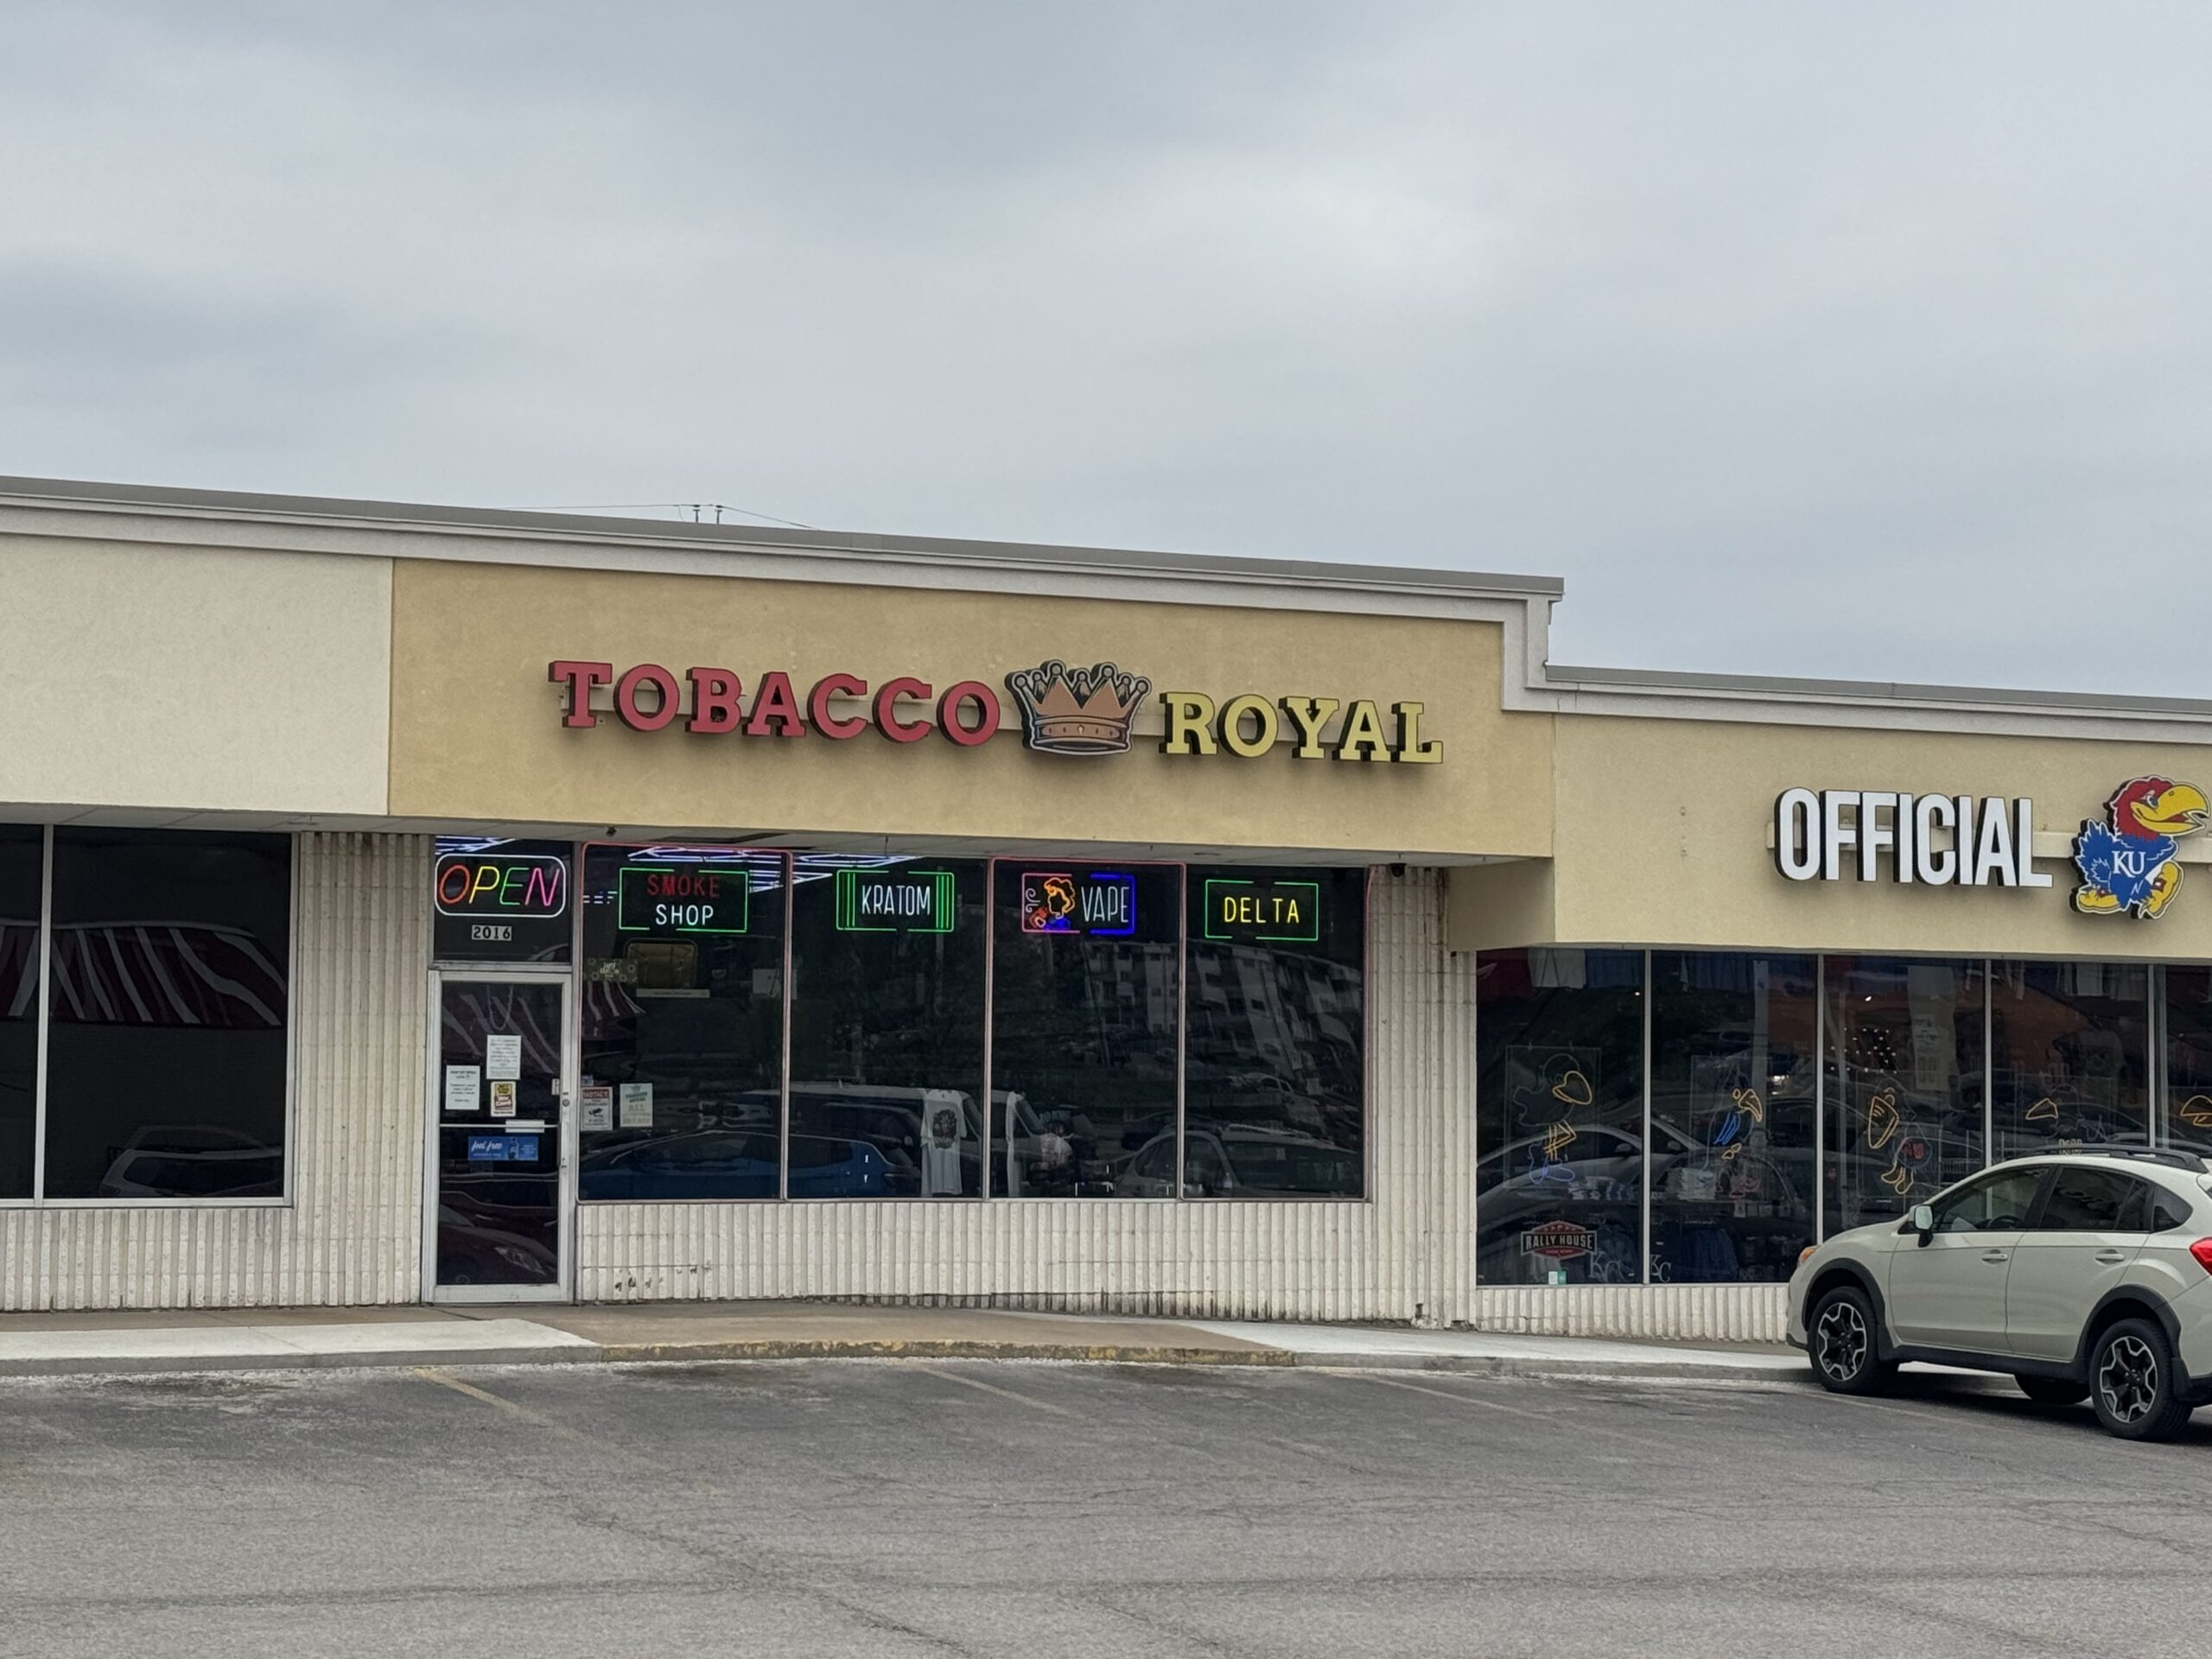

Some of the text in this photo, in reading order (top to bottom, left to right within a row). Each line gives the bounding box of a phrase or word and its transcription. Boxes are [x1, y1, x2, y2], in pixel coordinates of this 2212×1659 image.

[549, 660, 1444, 764] TOBACCO ROYAL
[1775, 787, 2054, 888] OFFICIAL
[2111, 850, 2146, 878] KU
[439, 864, 561, 906] OPEN
[647, 874, 721, 898] SMOKE
[861, 884, 931, 916] KRATOM
[1080, 886, 1130, 923] VAPE
[1224, 896, 1300, 924] DELTA
[655, 903, 715, 926] SHOP
[473, 926, 512, 940] 2016
[1525, 1234, 1593, 1250] RALLY HOUSE
[1649, 1254, 1672, 1283] KC
